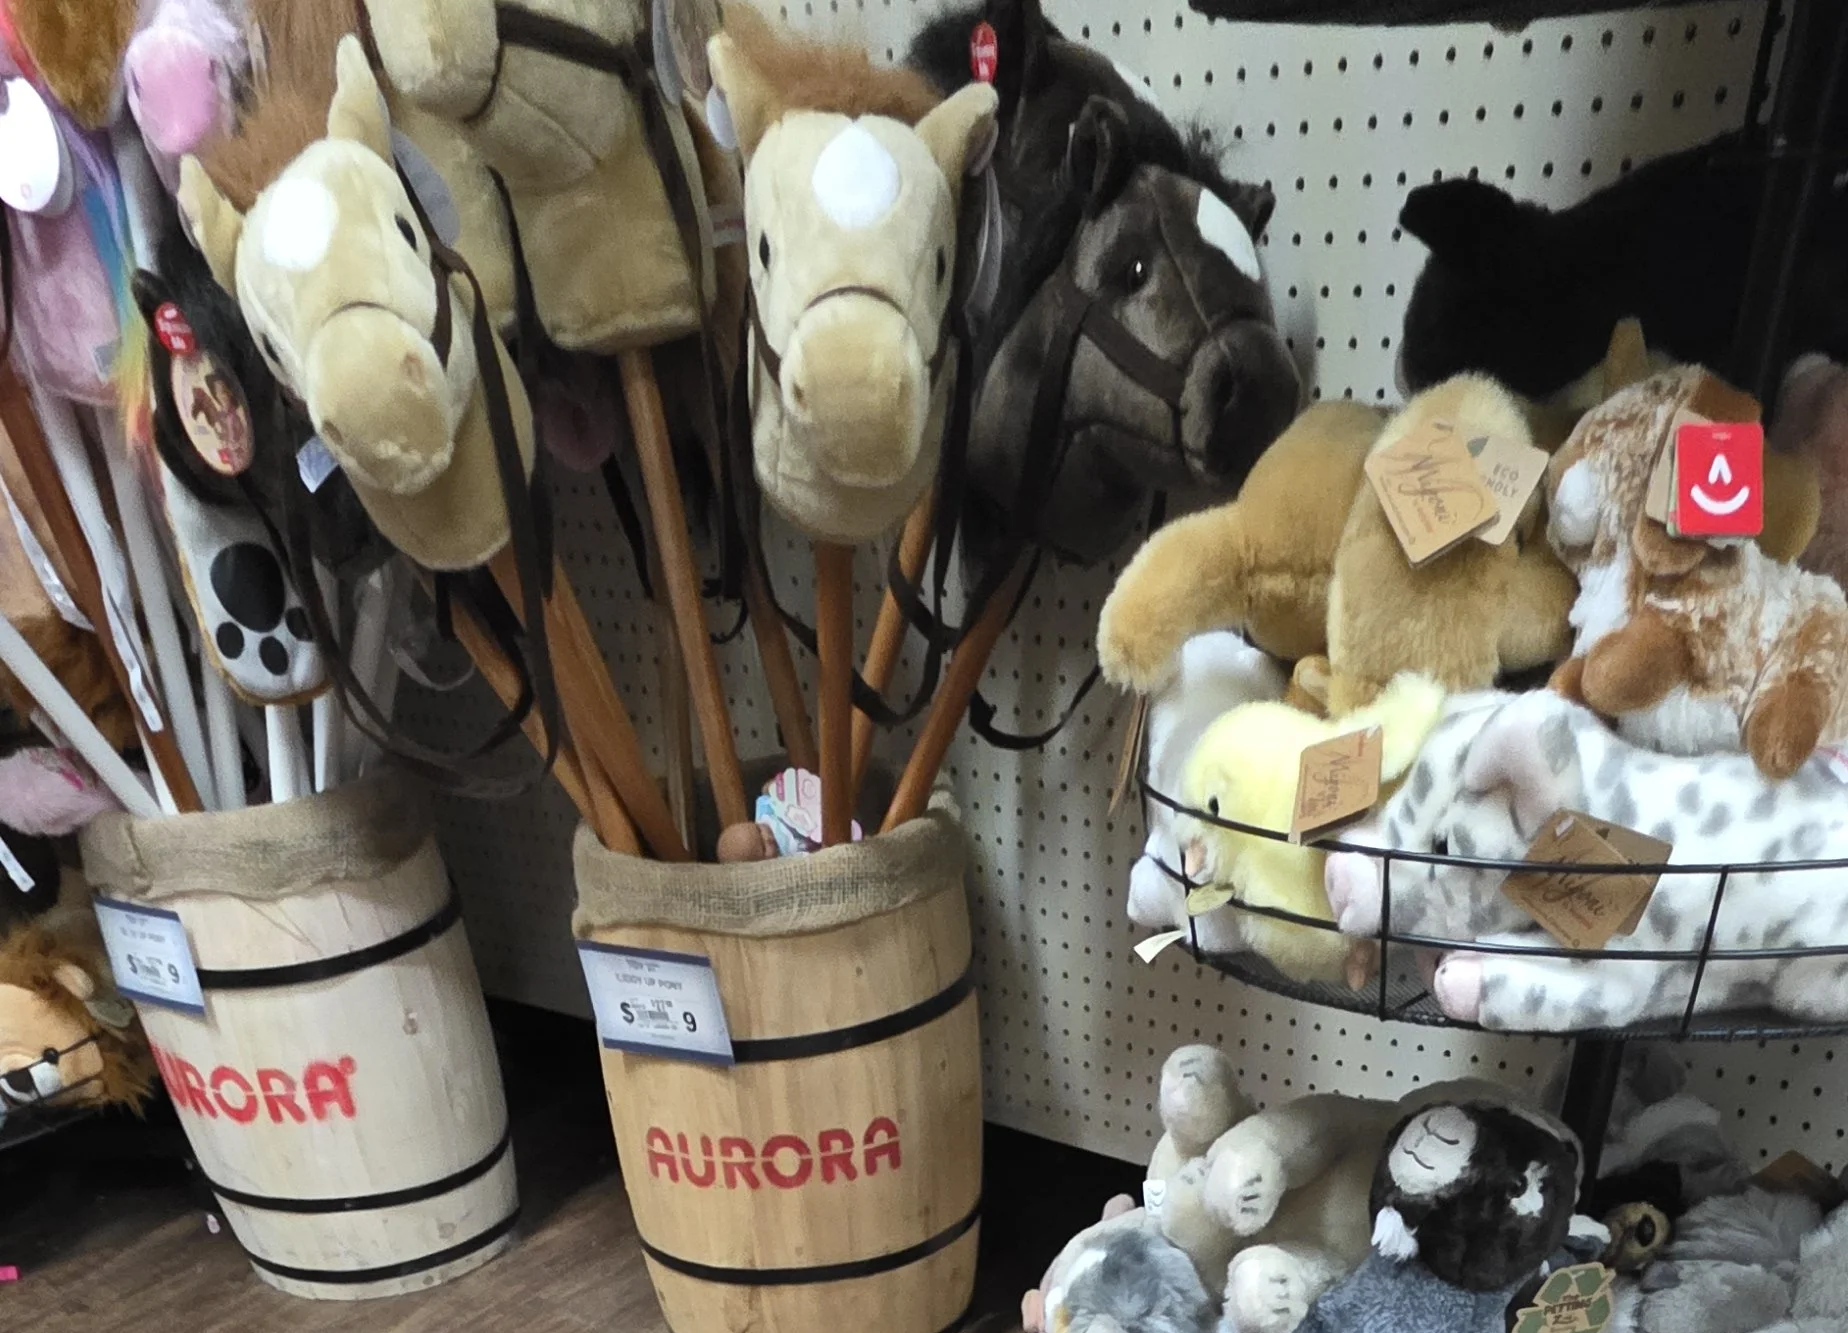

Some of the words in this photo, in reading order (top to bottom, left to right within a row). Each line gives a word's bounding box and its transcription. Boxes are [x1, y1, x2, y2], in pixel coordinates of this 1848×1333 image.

[1492, 462, 1520, 482] ECO
[1482, 475, 1519, 499] NDLY
[167, 963, 180, 984] 9
[682, 1011, 697, 1033] 9
[150, 1043, 356, 1124] URORA
[646, 1116, 900, 1190] AURORA
